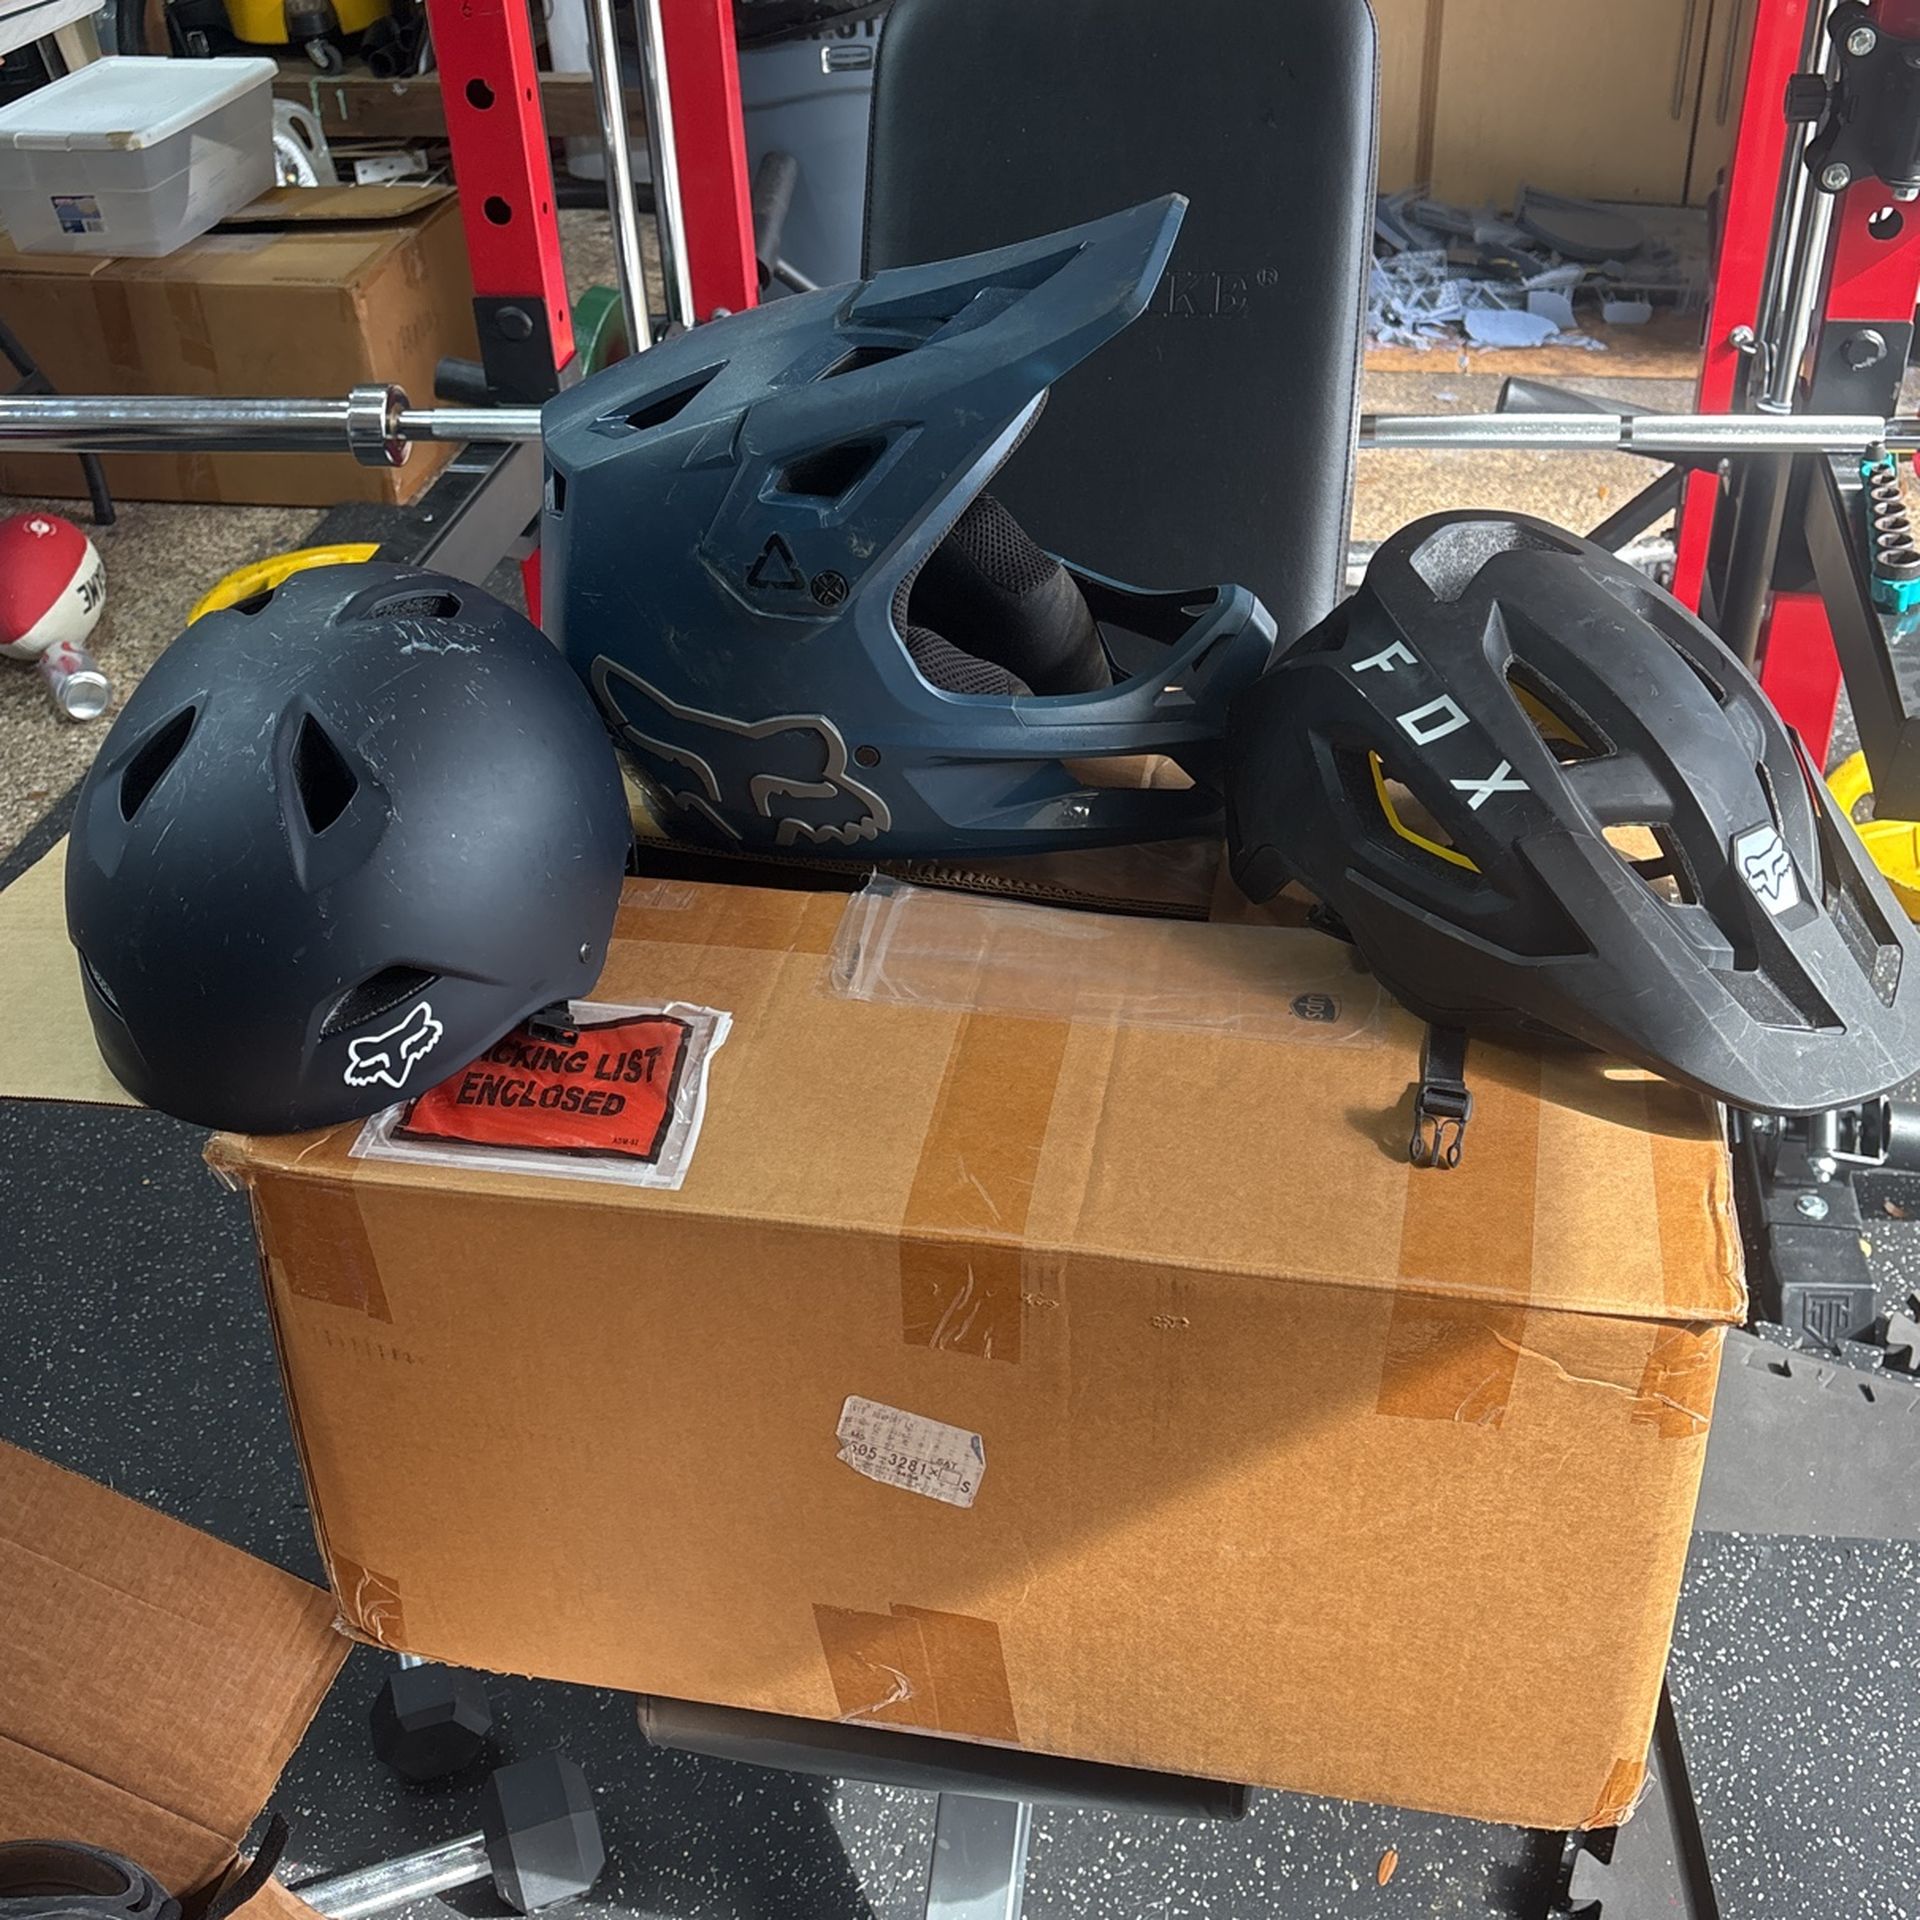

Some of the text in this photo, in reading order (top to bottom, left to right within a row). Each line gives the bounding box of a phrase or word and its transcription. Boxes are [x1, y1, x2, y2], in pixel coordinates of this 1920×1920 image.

[1351, 640, 1531, 811] FOX
[480, 1041, 663, 1083] CKING LIST
[456, 1071, 627, 1117] ENCLOSED
